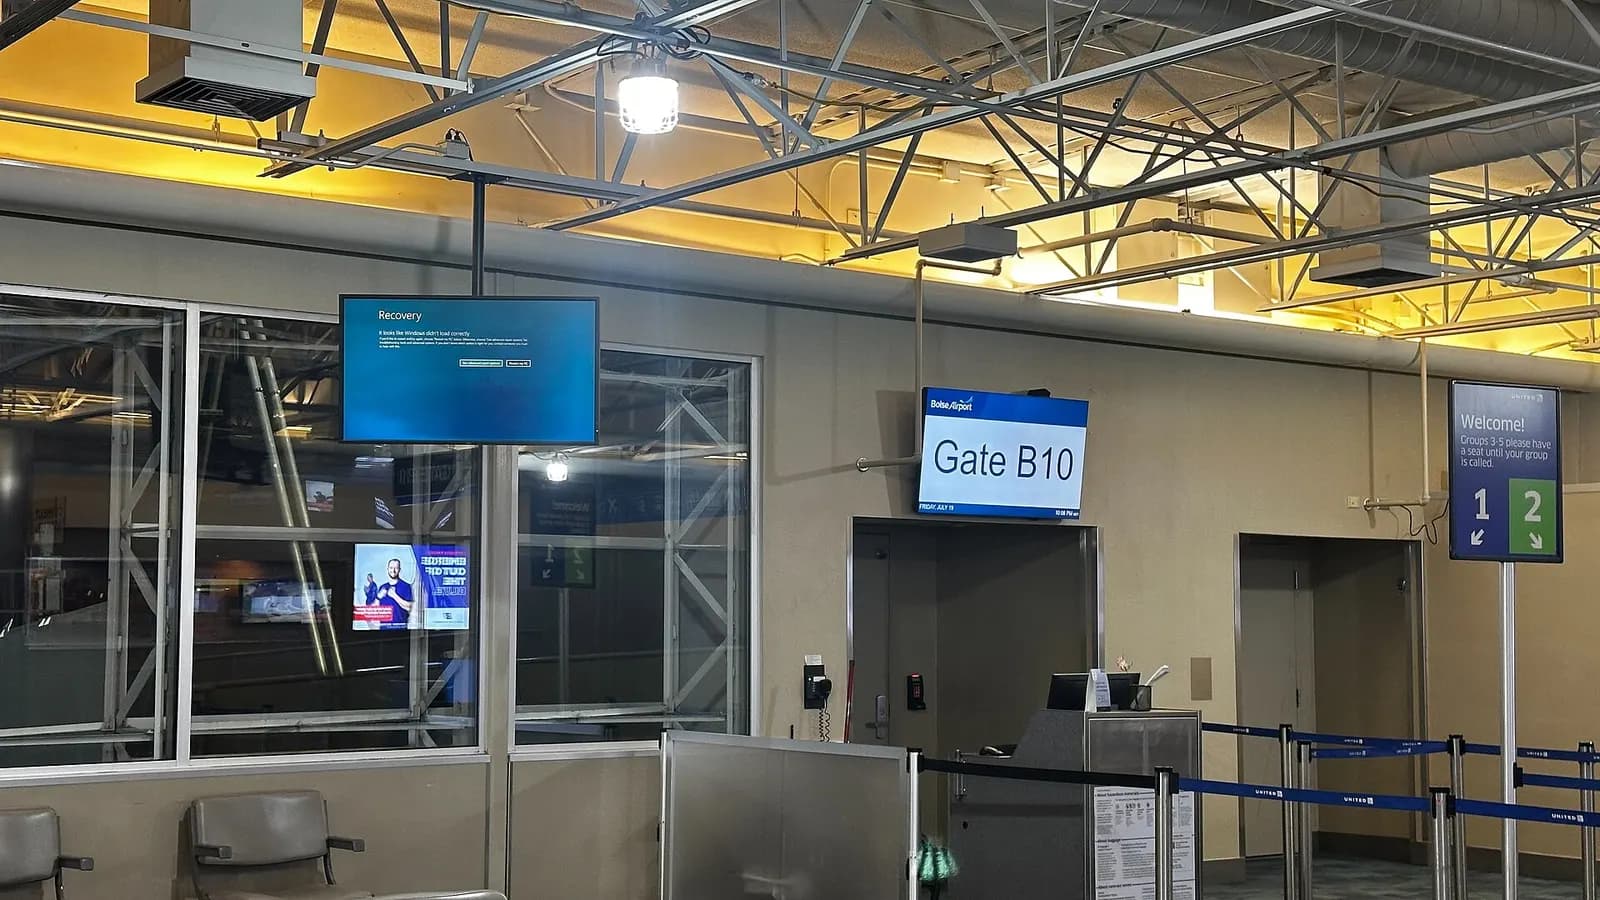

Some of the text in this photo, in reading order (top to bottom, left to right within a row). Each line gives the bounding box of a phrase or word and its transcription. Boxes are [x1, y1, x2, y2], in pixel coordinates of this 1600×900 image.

[378, 310, 422, 323] Recovery
[948, 401, 972, 412] Airport
[1461, 414, 1525, 432] Welcome!
[1460, 434, 1551, 450] Groups 3-5 please have
[934, 440, 1074, 481] Gate B10
[1461, 447, 1548, 461] a seat until your group
[1461, 457, 1494, 468] is called.
[1474, 488, 1490, 520] 1
[1524, 490, 1542, 522] 2
[1551, 813, 1576, 821] UNITED
